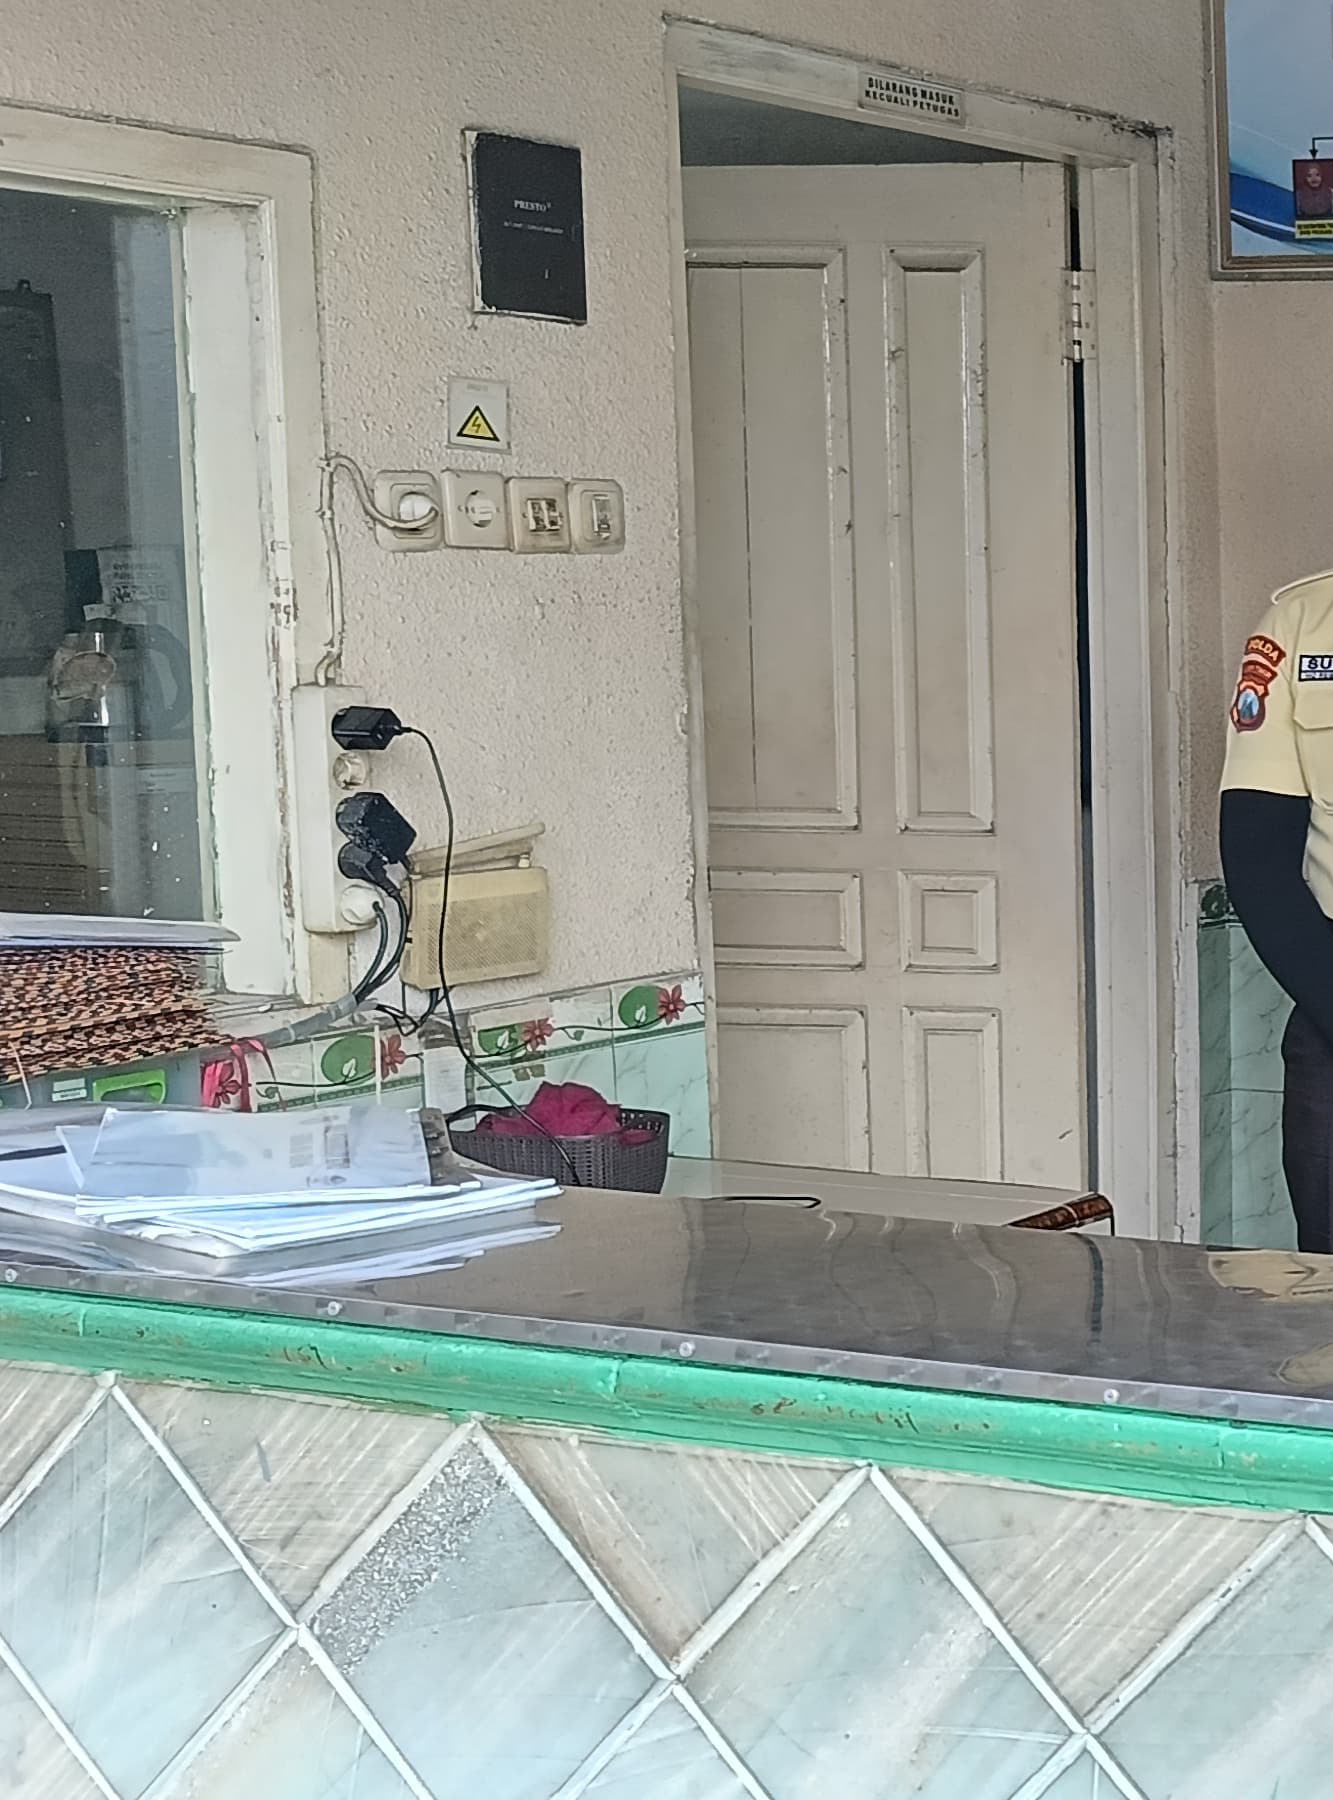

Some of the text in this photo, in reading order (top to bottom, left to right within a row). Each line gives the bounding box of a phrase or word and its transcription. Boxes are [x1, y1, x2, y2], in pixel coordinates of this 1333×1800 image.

[865, 89, 959, 117] KECUALI PETUGAS
[868, 77, 954, 105] DILARANG MASUK
